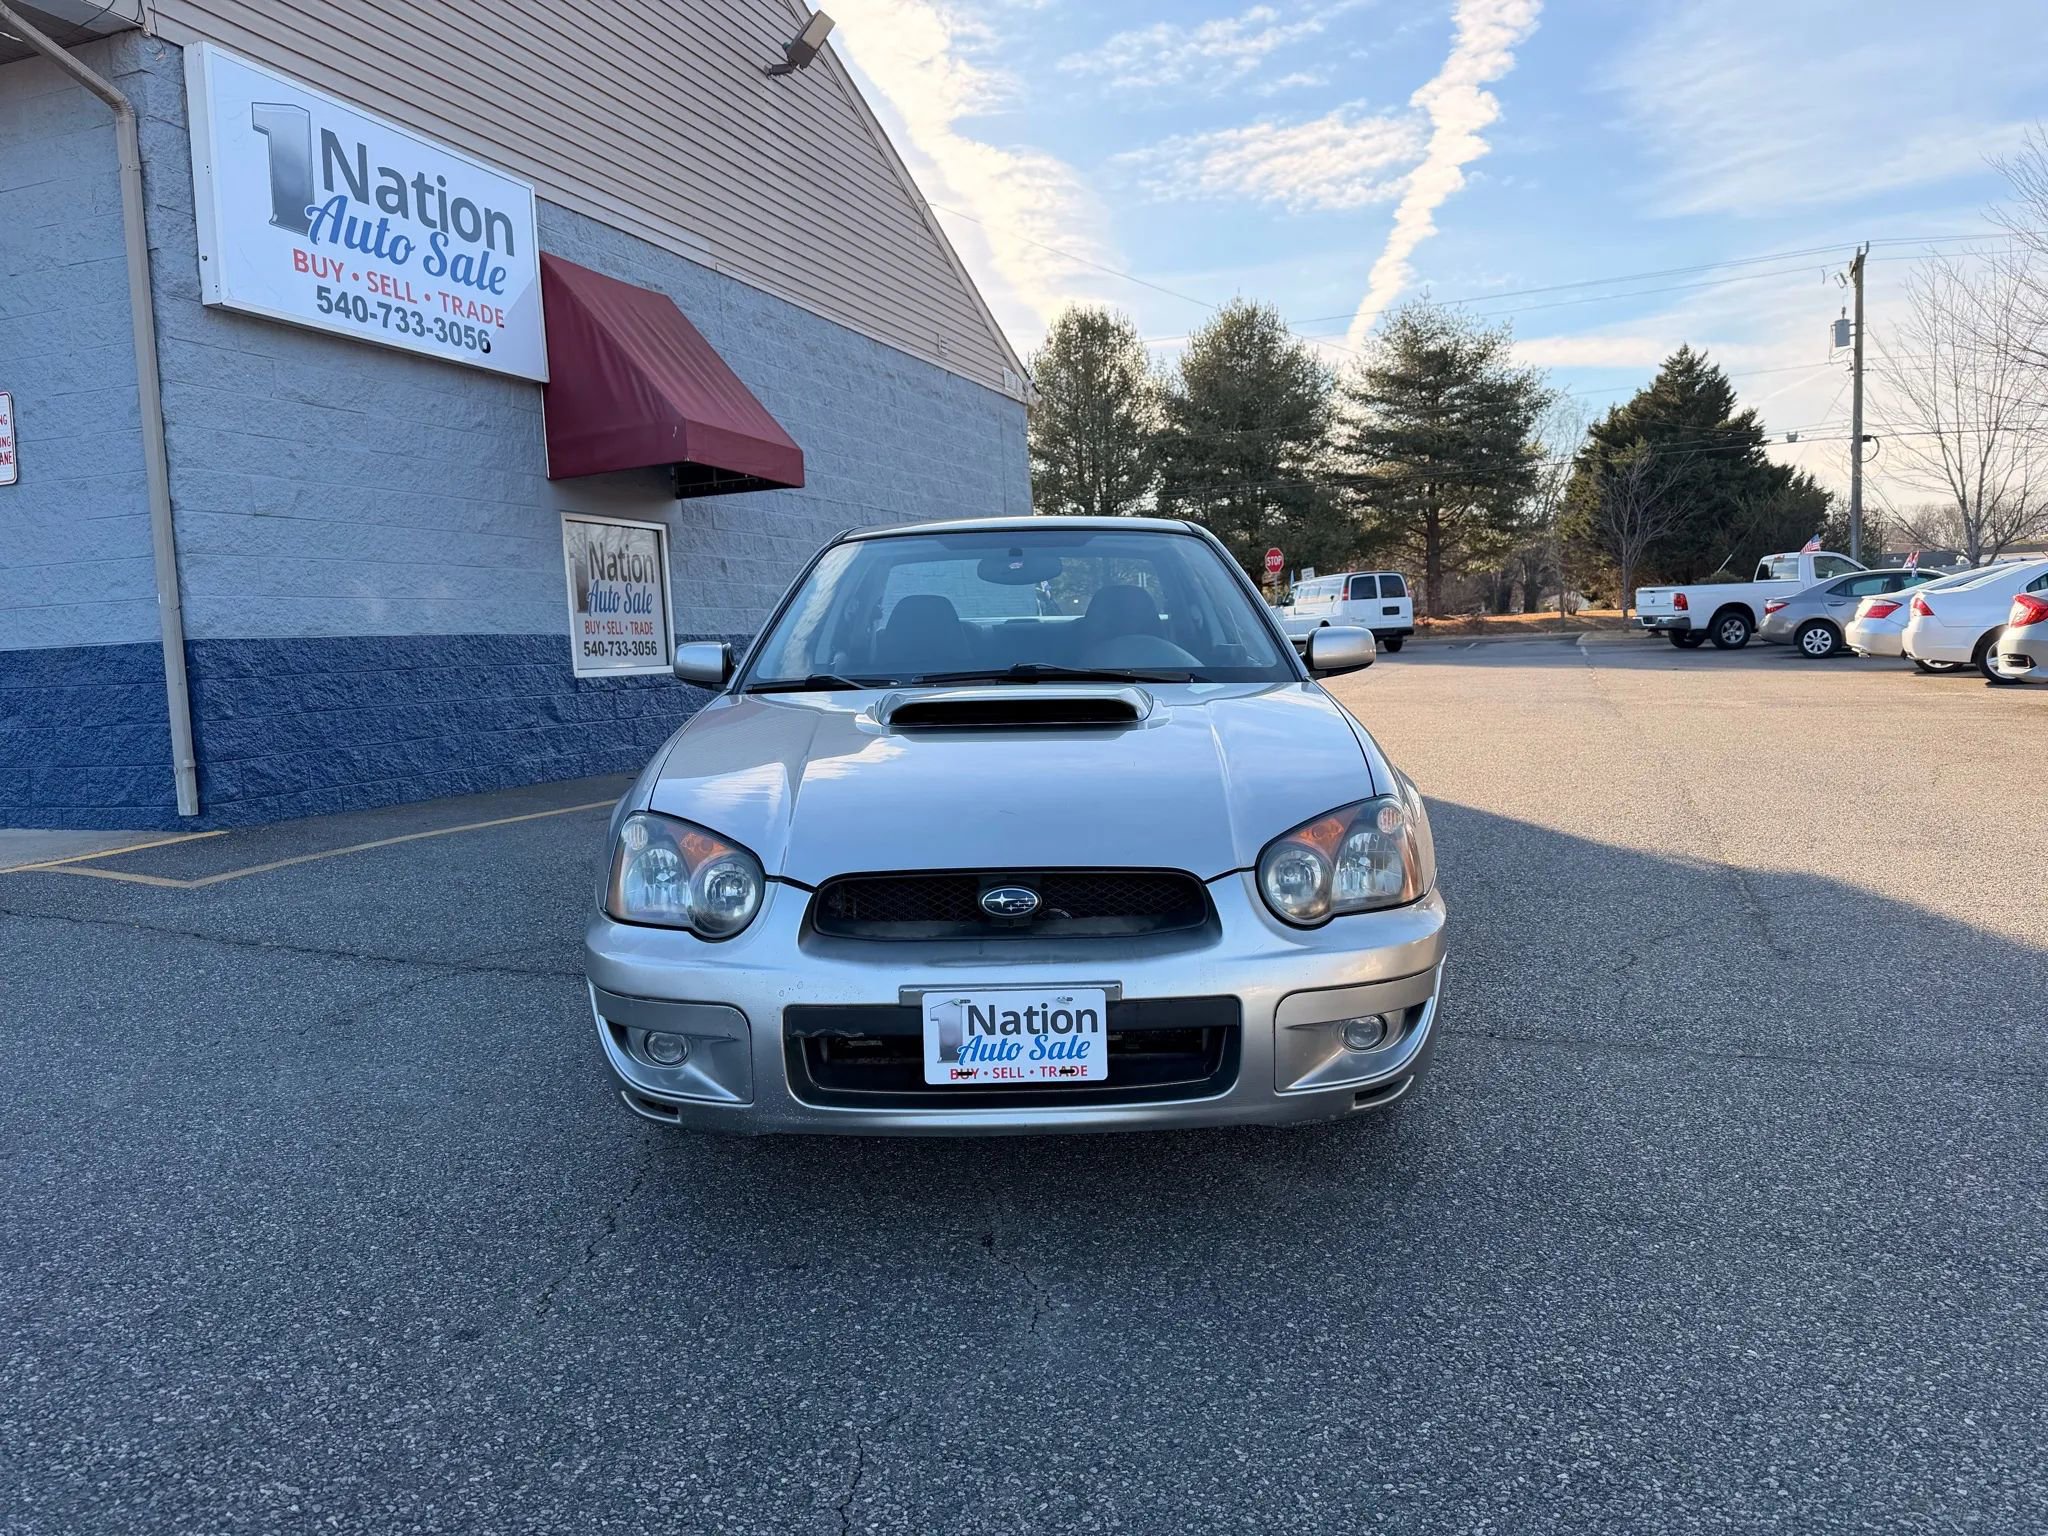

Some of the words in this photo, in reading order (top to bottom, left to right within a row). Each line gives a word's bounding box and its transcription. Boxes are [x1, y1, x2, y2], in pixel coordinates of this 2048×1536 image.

[251, 101, 314, 235] 1
[320, 127, 515, 257] Nation
[305, 194, 415, 265] Auto
[423, 231, 507, 296] Sale
[293, 248, 344, 283] BUY
[366, 270, 418, 304] SELL
[437, 291, 505, 328] TRADE
[316, 285, 491, 354] 540-733-3056
[588, 541, 655, 584] Nation
[1266, 555, 1283, 567] STOP
[587, 578, 621, 617] Auto
[623, 582, 653, 615] Sale
[584, 621, 600, 635] BUY
[606, 621, 624, 635] SELL
[630, 621, 653, 635] TRADE
[583, 640, 658, 657] 540-733-3056
[967, 1002, 1099, 1036] Nation
[957, 1034, 1024, 1066] Auto
[1028, 1034, 1091, 1061] Sale
[992, 1067, 1025, 1079] SELL
